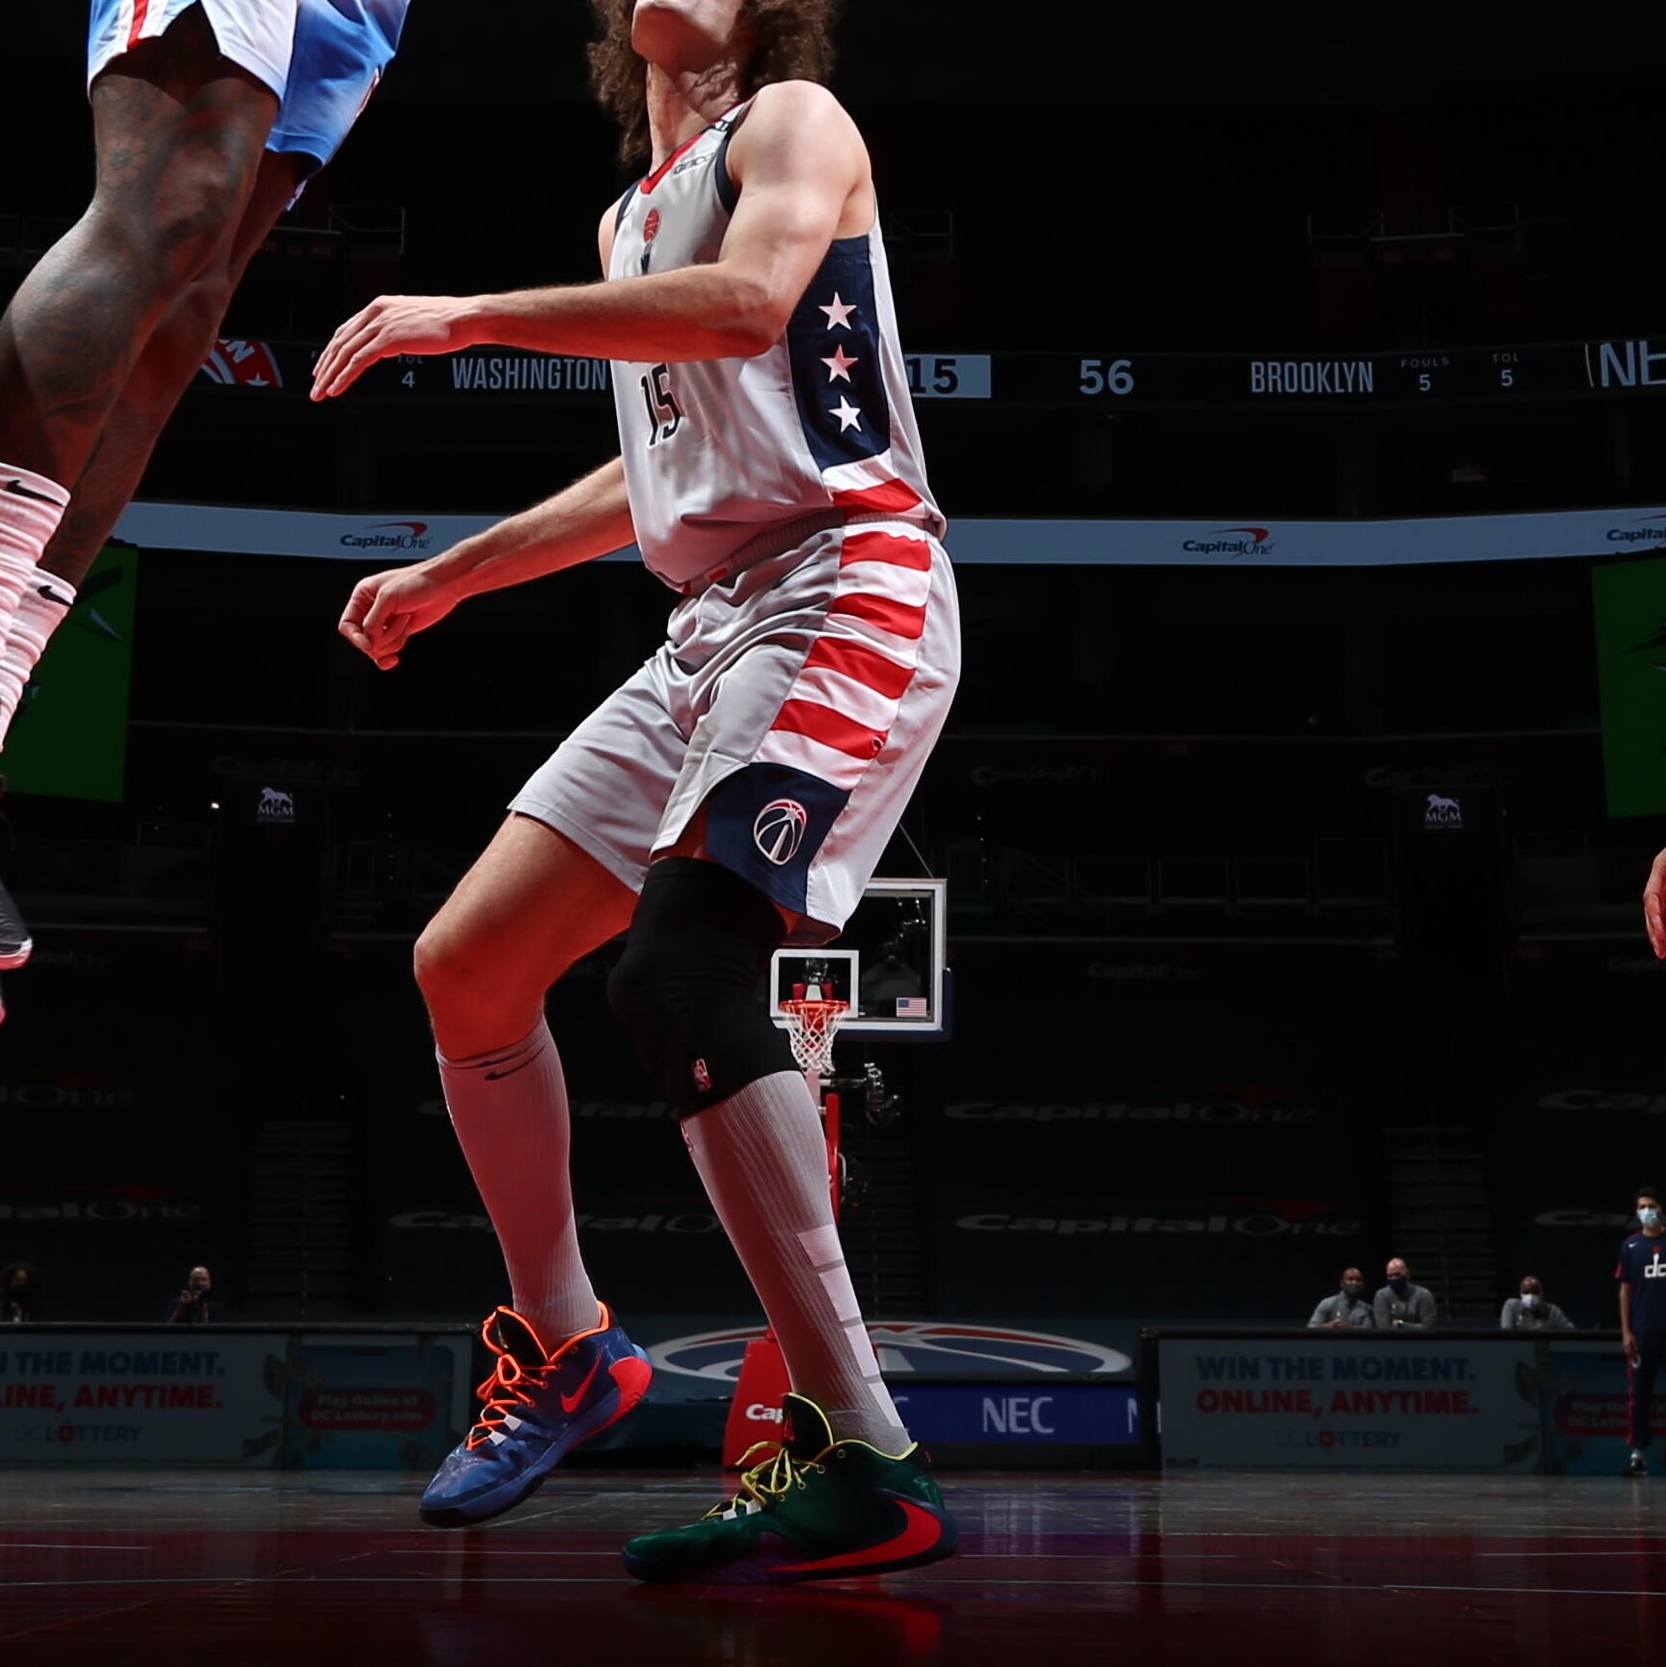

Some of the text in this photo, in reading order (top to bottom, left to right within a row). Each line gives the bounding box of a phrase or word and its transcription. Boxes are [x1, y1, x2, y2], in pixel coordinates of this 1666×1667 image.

[1400, 355, 1450, 369] FOULS
[1492, 352, 1520, 364] TOL
[400, 370, 416, 389] 4
[451, 357, 607, 391] WASHINGTON
[1078, 358, 1134, 396] 56
[1250, 360, 1374, 394] BROOKLYN
[1419, 373, 1432, 392] 5
[1500, 368, 1513, 387] 5
[641, 363, 681, 446] 15
[1424, 812, 1463, 823] MGM
[15, 1351, 72, 1375] THE
[79, 1351, 226, 1376] MOMENT.
[1195, 1356, 1477, 1382] WIN THE MOMENT.
[75, 1384, 225, 1409] ANYTIME.
[1197, 1389, 1480, 1418] ONLINE, ANYTIME.
[982, 1396, 1055, 1434] NEC
